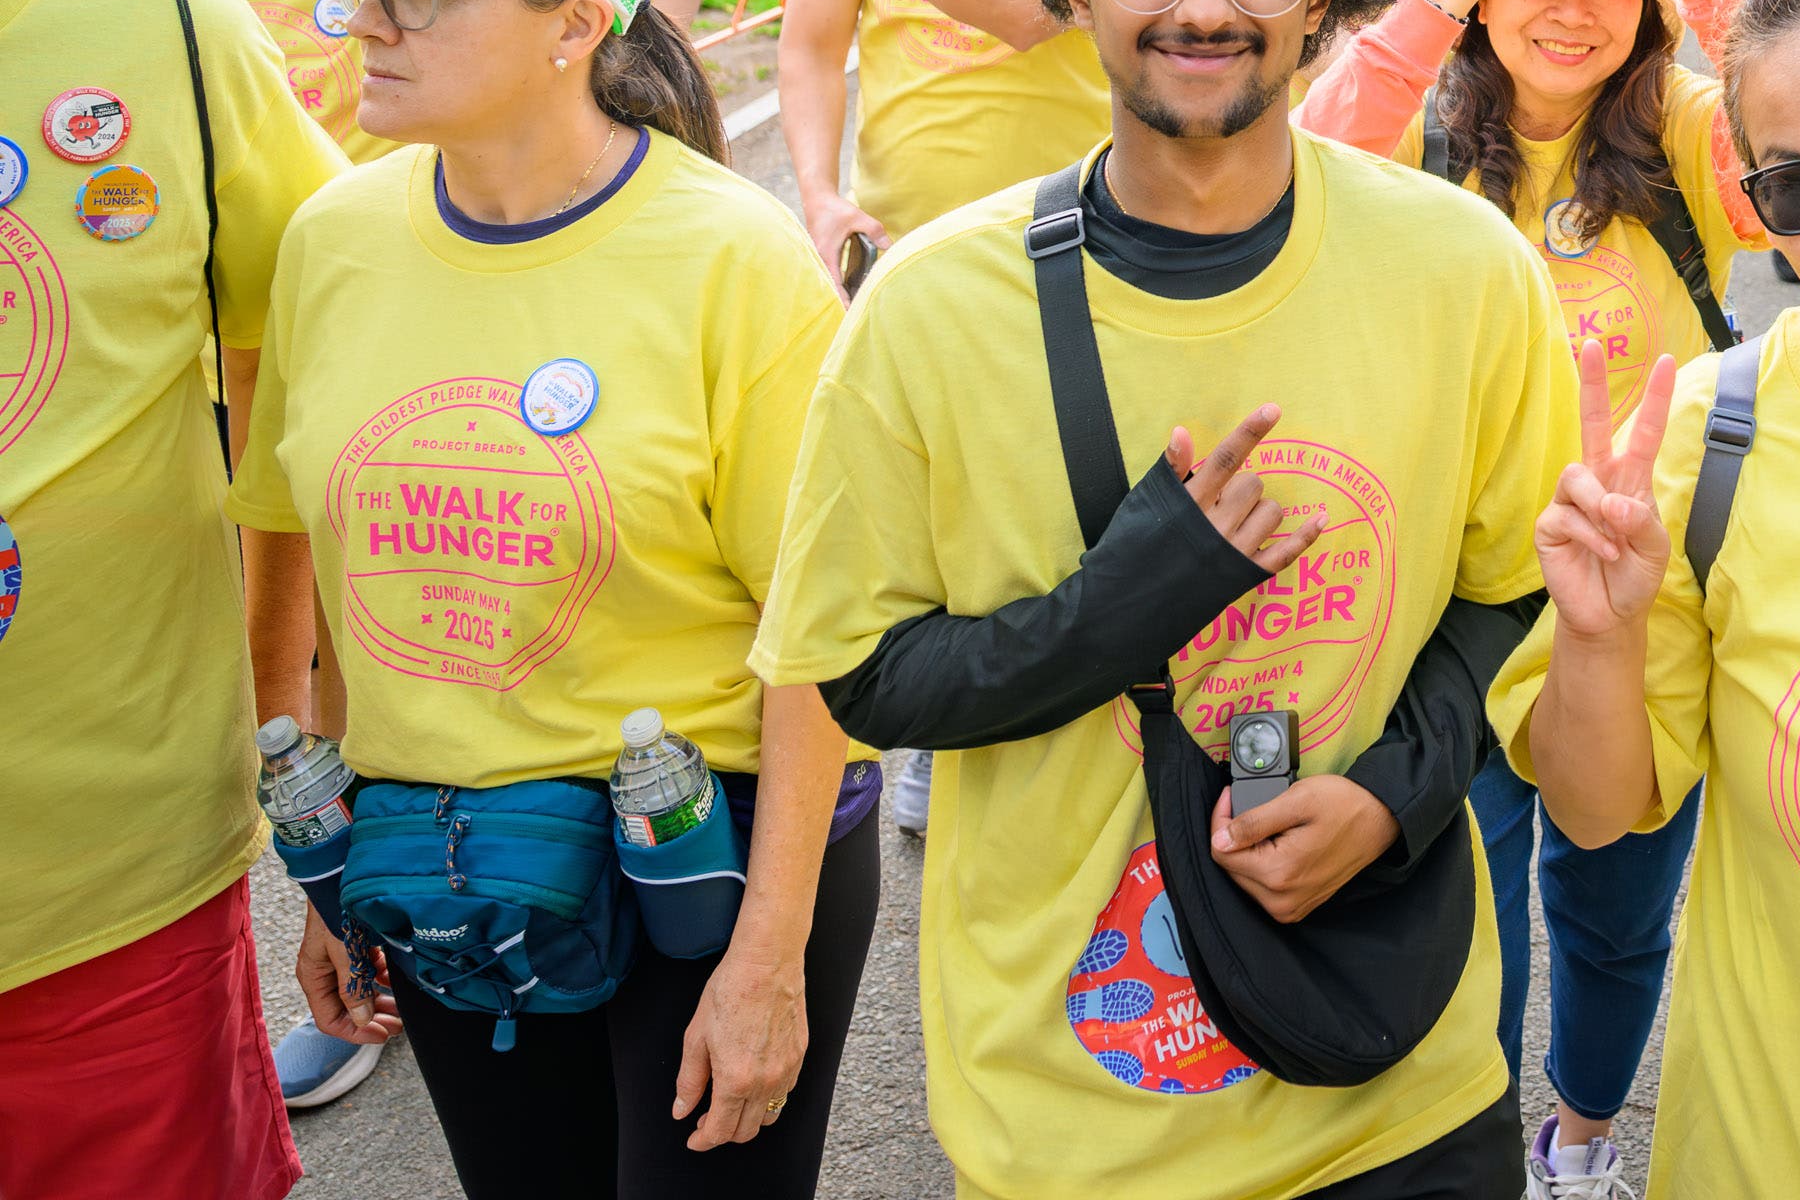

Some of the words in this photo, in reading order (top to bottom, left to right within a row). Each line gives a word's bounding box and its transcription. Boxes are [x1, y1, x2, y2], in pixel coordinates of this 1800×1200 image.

[302, 68, 326, 81] FOR
[93, 197, 146, 206] HUNGER
[103, 188, 139, 196] WALK
[1605, 305, 1635, 326] FOR
[345, 436, 372, 466] THE
[370, 403, 426, 438] OLDEST
[430, 385, 483, 406] PLEDGE
[412, 439, 471, 453] PROJECT
[474, 442, 526, 456] BREAD'S
[553, 433, 589, 477] ERICA
[1260, 449, 1306, 466] WALK
[1311, 453, 1331, 471] IN
[1332, 466, 1386, 519] AMERICA
[356, 491, 392, 510] THE
[399, 483, 525, 527] WALK
[529, 502, 567, 522] FOR
[1282, 501, 1327, 518] EAD'S
[369, 522, 556, 568] HUNGER
[1332, 549, 1370, 573] FOR
[421, 585, 476, 606] SUNDAY
[479, 592, 501, 614] MAY
[504, 600, 512, 616] 4
[444, 609, 496, 650] 2025
[1178, 584, 1356, 662] UNGER
[440, 661, 481, 681] SINCE
[1202, 673, 1250, 695] NDAY
[1252, 662, 1289, 688] MAY
[1292, 659, 1304, 677] 4
[1193, 689, 1275, 734] 2025
[1130, 858, 1160, 886] TH
[1167, 987, 1197, 1003] PROJ
[1142, 1015, 1167, 1036] THE
[1166, 998, 1212, 1028] WA
[1154, 1020, 1218, 1063] HUN
[1175, 1049, 1208, 1070] SUNDAY
[1211, 1039, 1230, 1059] MAY
